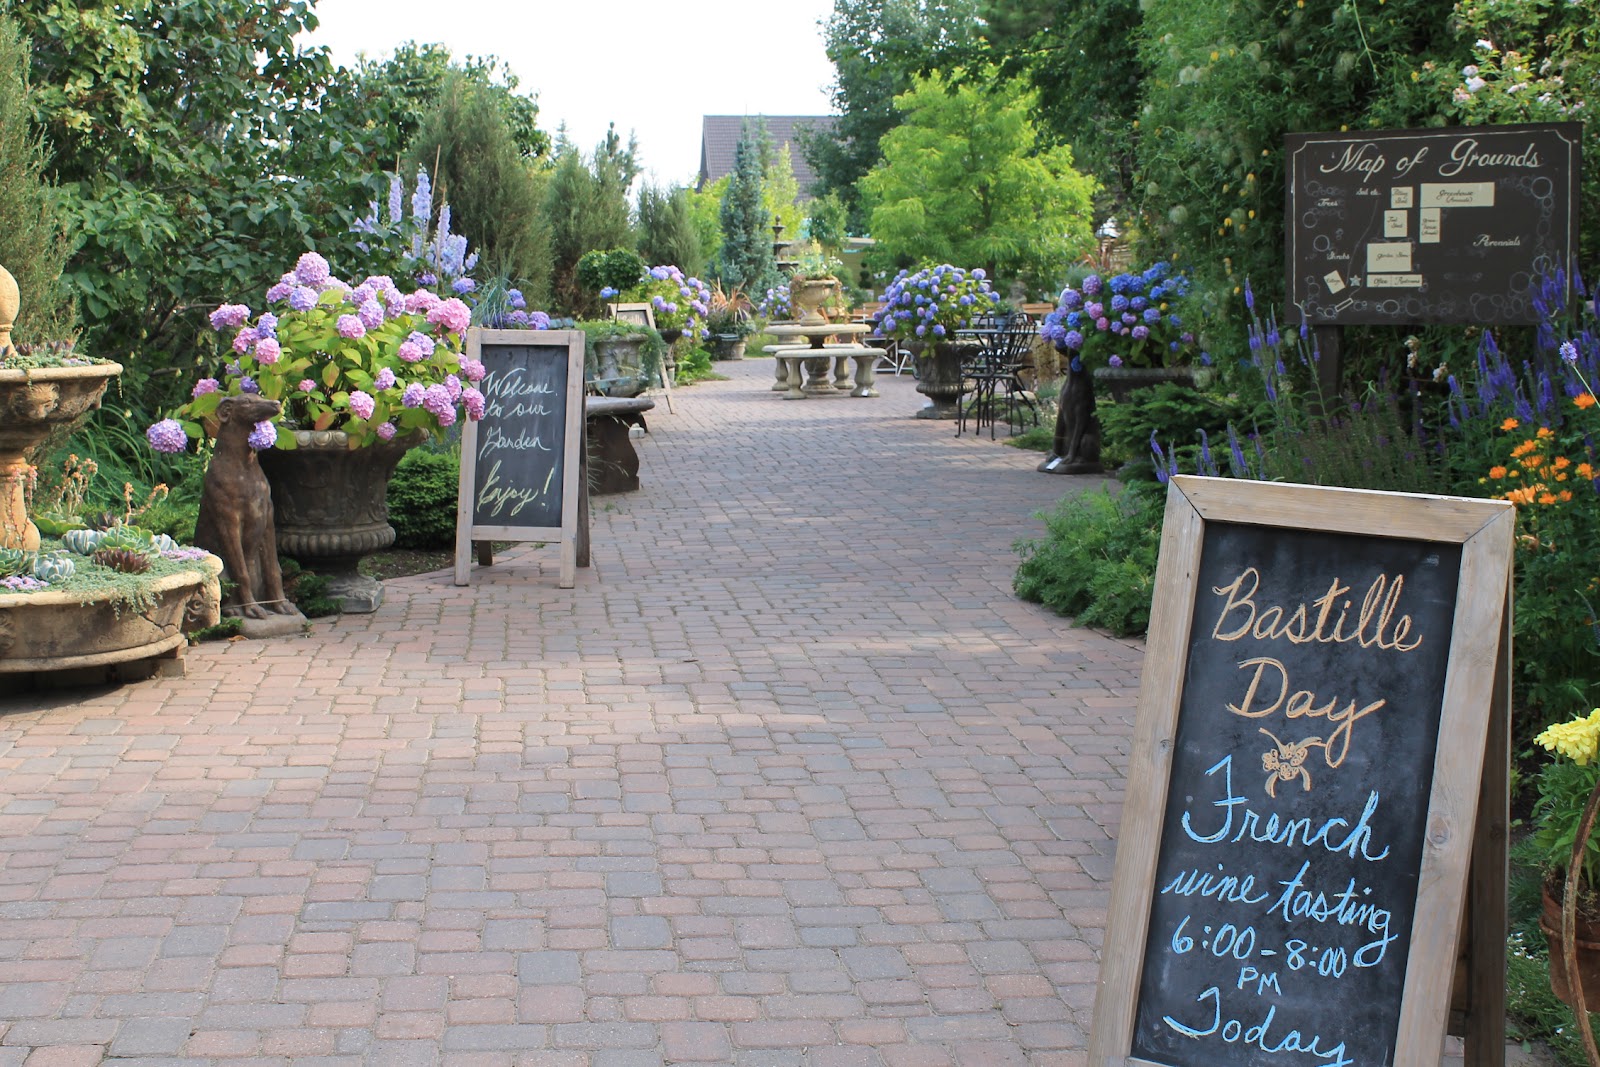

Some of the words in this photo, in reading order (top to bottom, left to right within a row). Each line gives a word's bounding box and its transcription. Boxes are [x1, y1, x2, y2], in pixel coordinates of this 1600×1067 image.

[1320, 143, 1386, 183] Map
[1393, 146, 1429, 179] of
[1438, 138, 1543, 177] Grounds
[1317, 197, 1339, 207] Trees
[1472, 233, 1521, 247] Perennials
[480, 398, 505, 420] to
[503, 402, 552, 420] our
[478, 426, 552, 461] Garden
[1211, 566, 1423, 652] Bastille
[1225, 656, 1386, 768] Day
[1181, 754, 1390, 861] French
[1160, 863, 1270, 904] wine
[1266, 860, 1399, 967] tasting
[1237, 966, 1282, 996] PM
[1162, 986, 1354, 1067] Today
